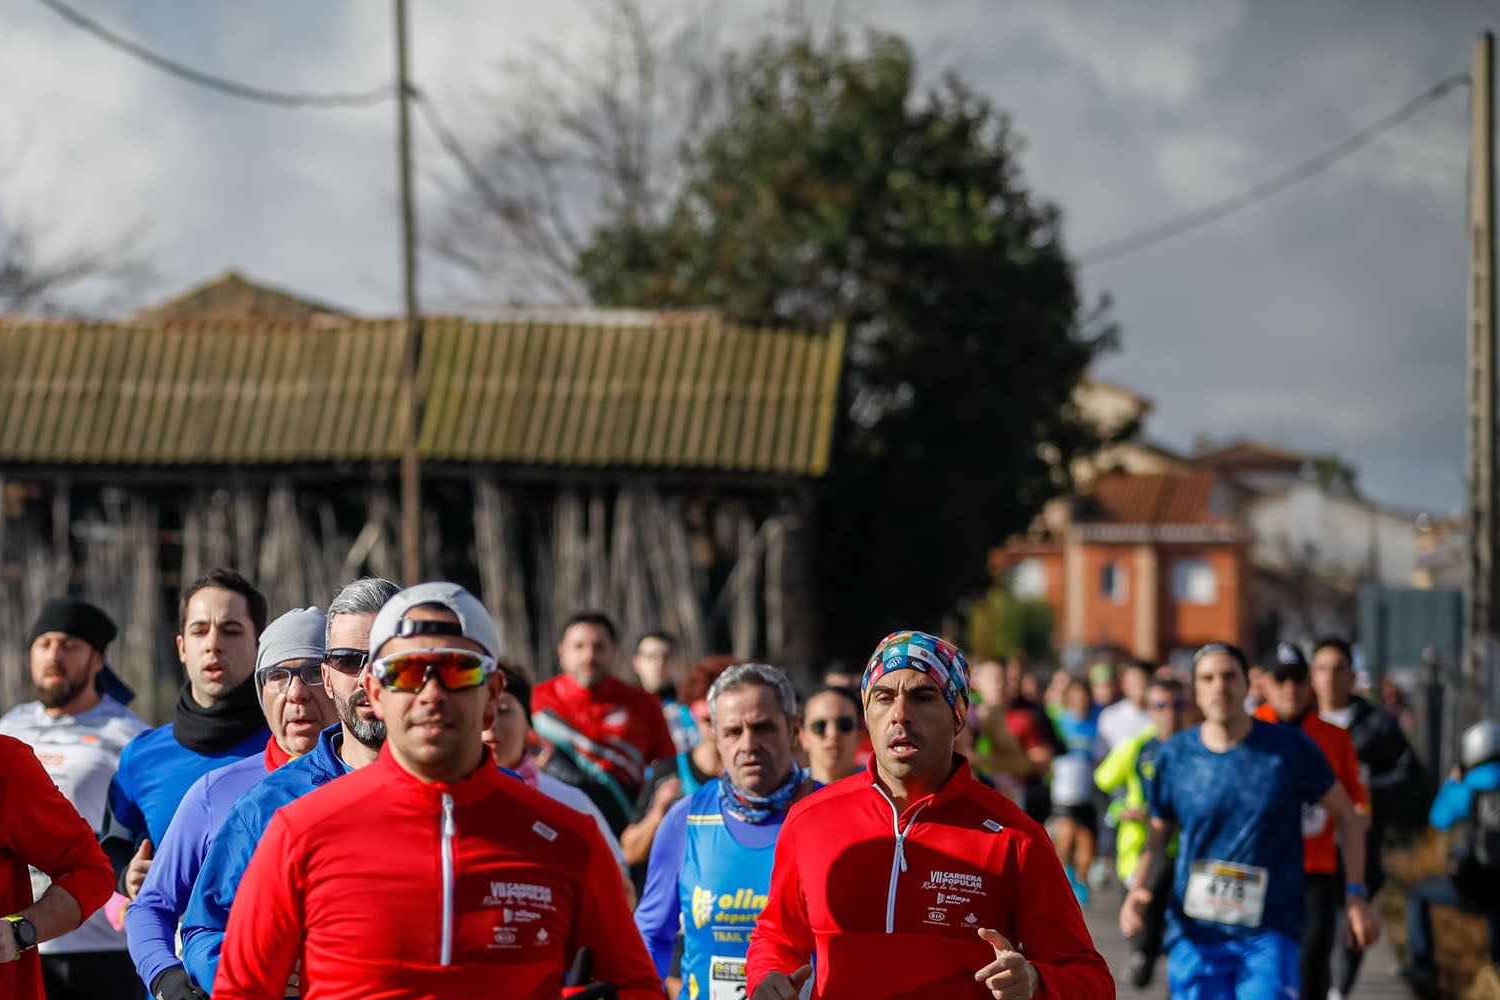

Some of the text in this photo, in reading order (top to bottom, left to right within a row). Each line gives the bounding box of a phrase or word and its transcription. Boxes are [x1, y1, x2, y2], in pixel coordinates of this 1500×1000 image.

[930, 870, 983, 884] VII CARRERA
[942, 878, 982, 889] POPULAR
[946, 894, 971, 903] olimpo
